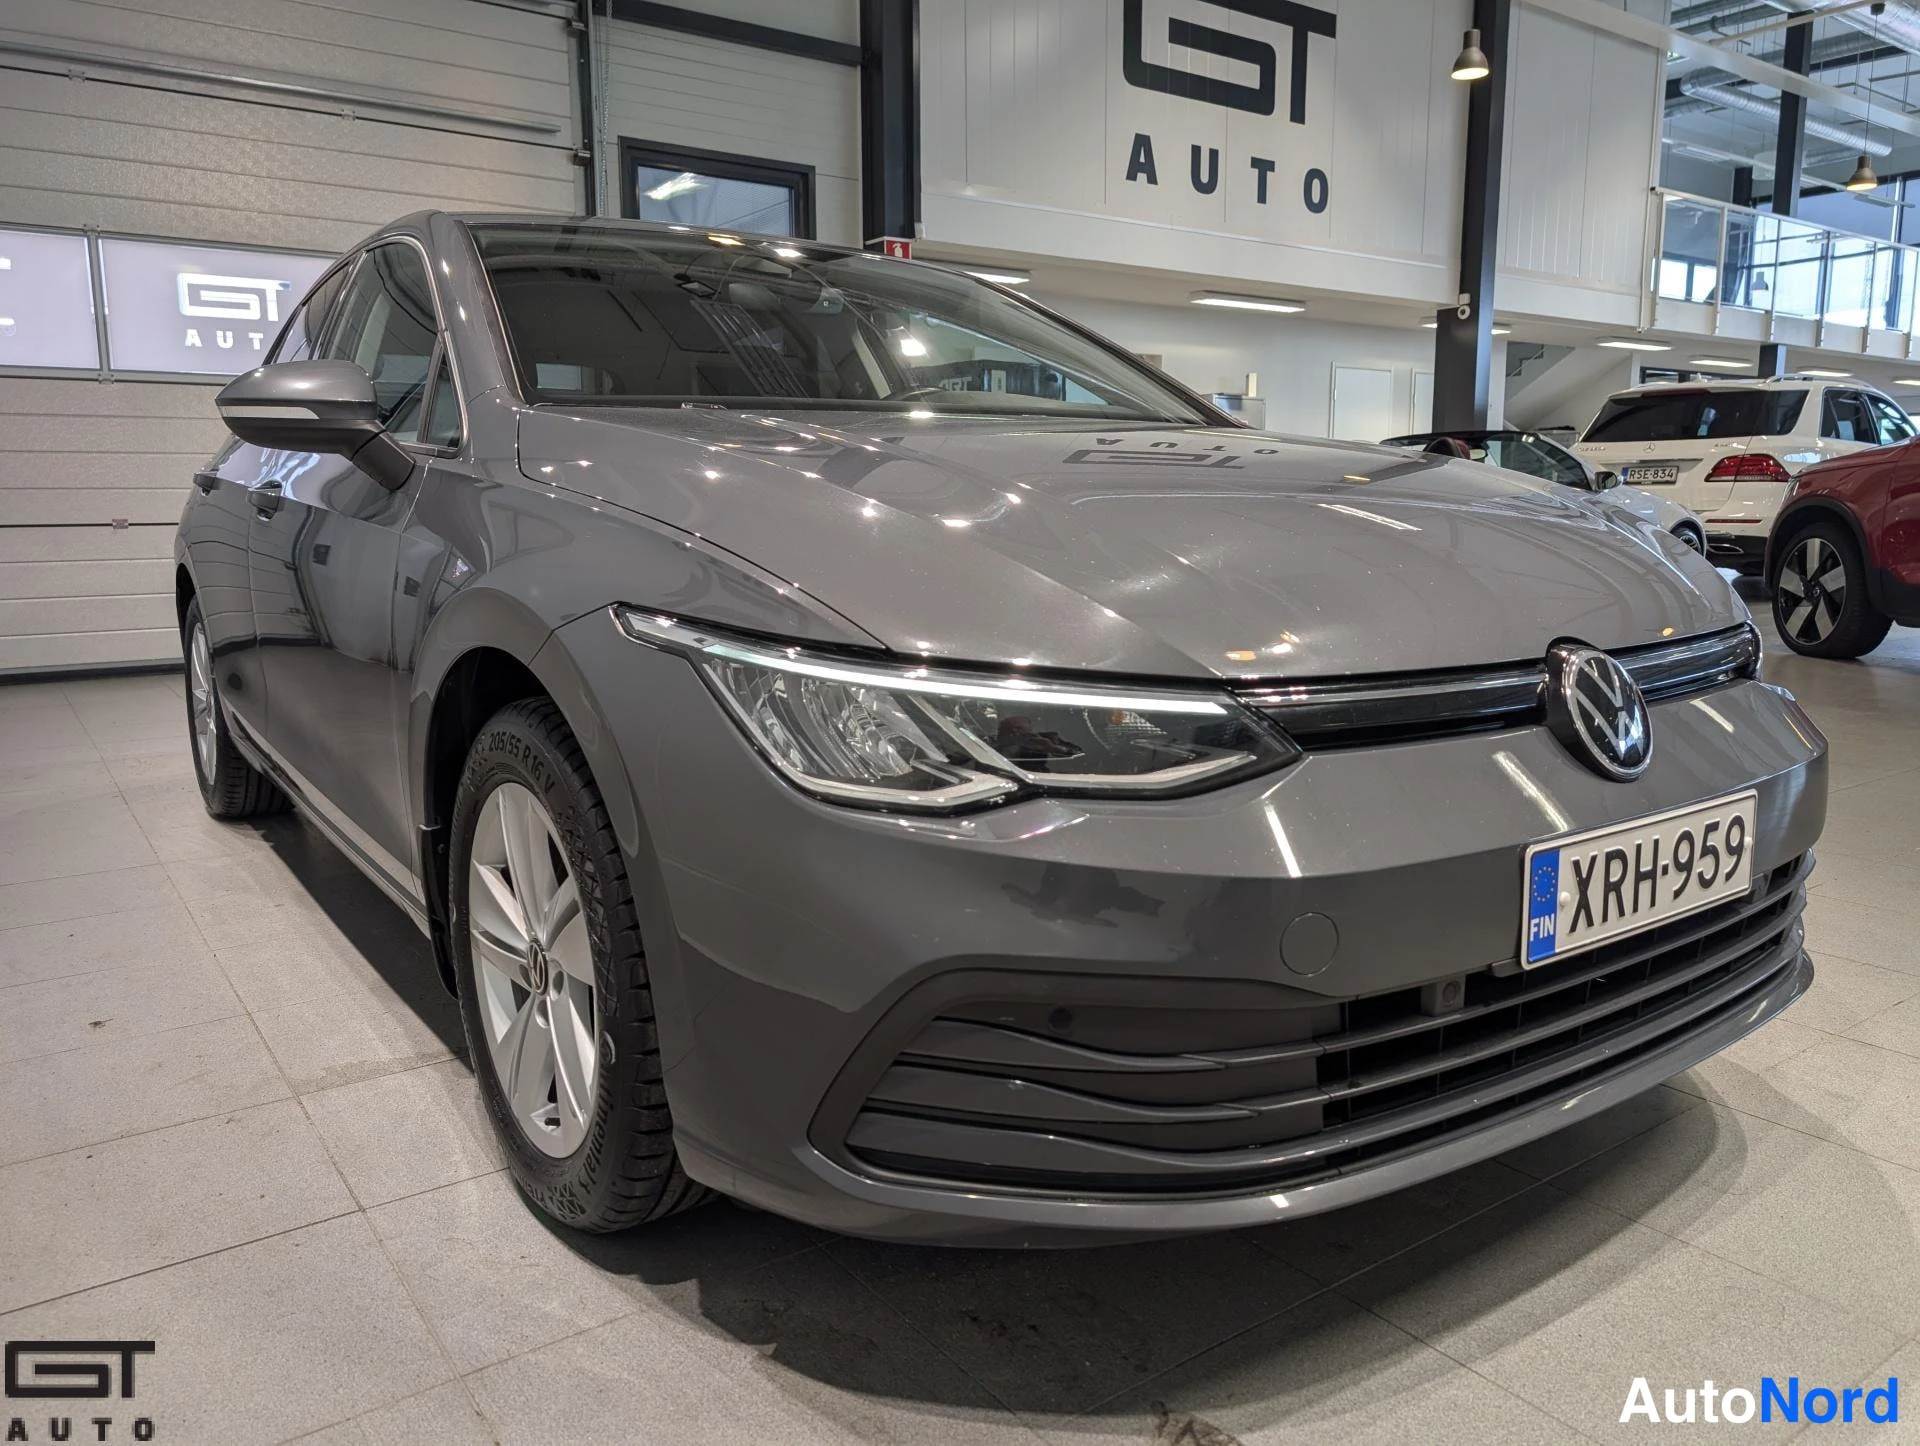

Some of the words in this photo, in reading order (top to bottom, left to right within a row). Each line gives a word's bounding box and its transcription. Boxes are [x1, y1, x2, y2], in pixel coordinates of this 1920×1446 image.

[1125, 132, 1329, 214] AUTO
[185, 328, 264, 350] AUT
[1629, 467, 1674, 480] RSE-834
[488, 731, 522, 758] 205/55
[522, 744, 531, 768] R
[531, 754, 545, 781] 16
[1568, 814, 1746, 934] XRH-959
[1530, 913, 1555, 942] FIN
